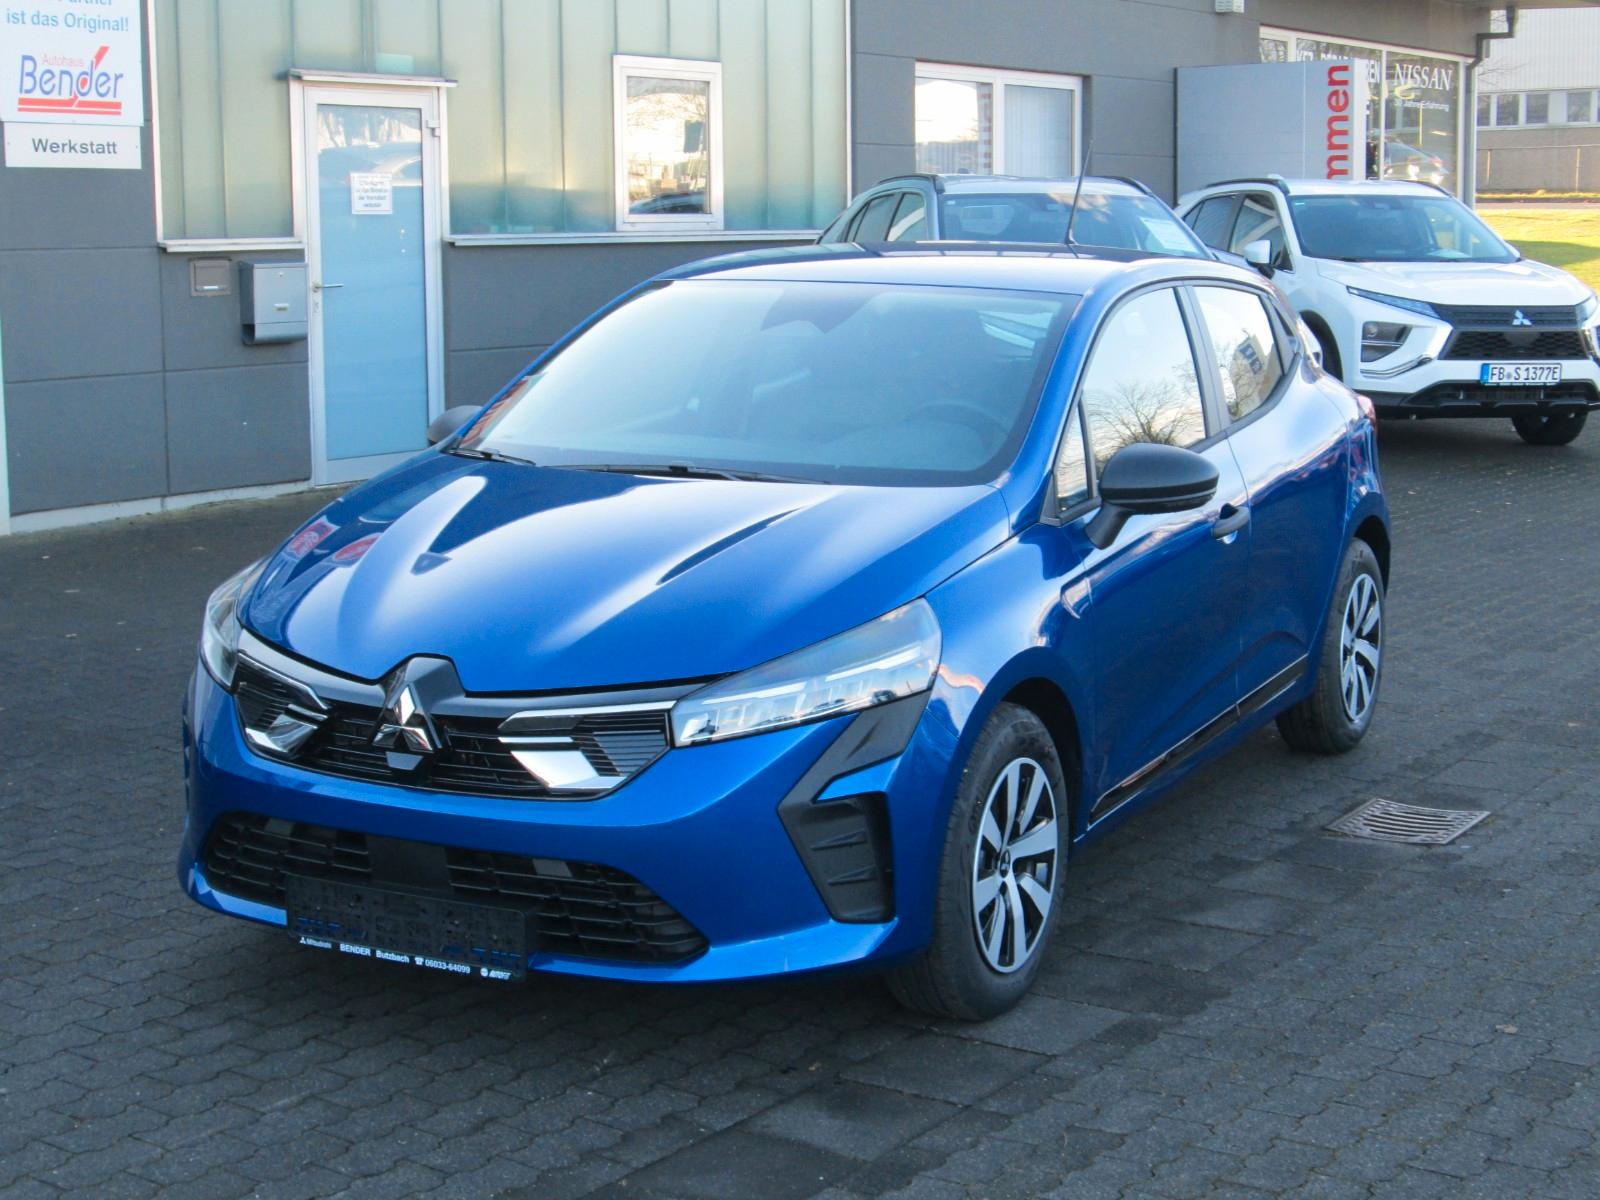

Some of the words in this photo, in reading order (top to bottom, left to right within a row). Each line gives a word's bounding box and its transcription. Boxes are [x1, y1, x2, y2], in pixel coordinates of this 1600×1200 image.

[6, 9, 26, 25] ist
[31, 10, 58, 27] das
[64, 12, 129, 33] Original!
[19, 54, 124, 98] Bender
[1394, 63, 1453, 91] NISSAN
[32, 138, 118, 154] Werkstatt
[1523, 366, 1559, 381] 1377E
[340, 943, 371, 957] BENDER
[375, 949, 410, 963] Butzbach
